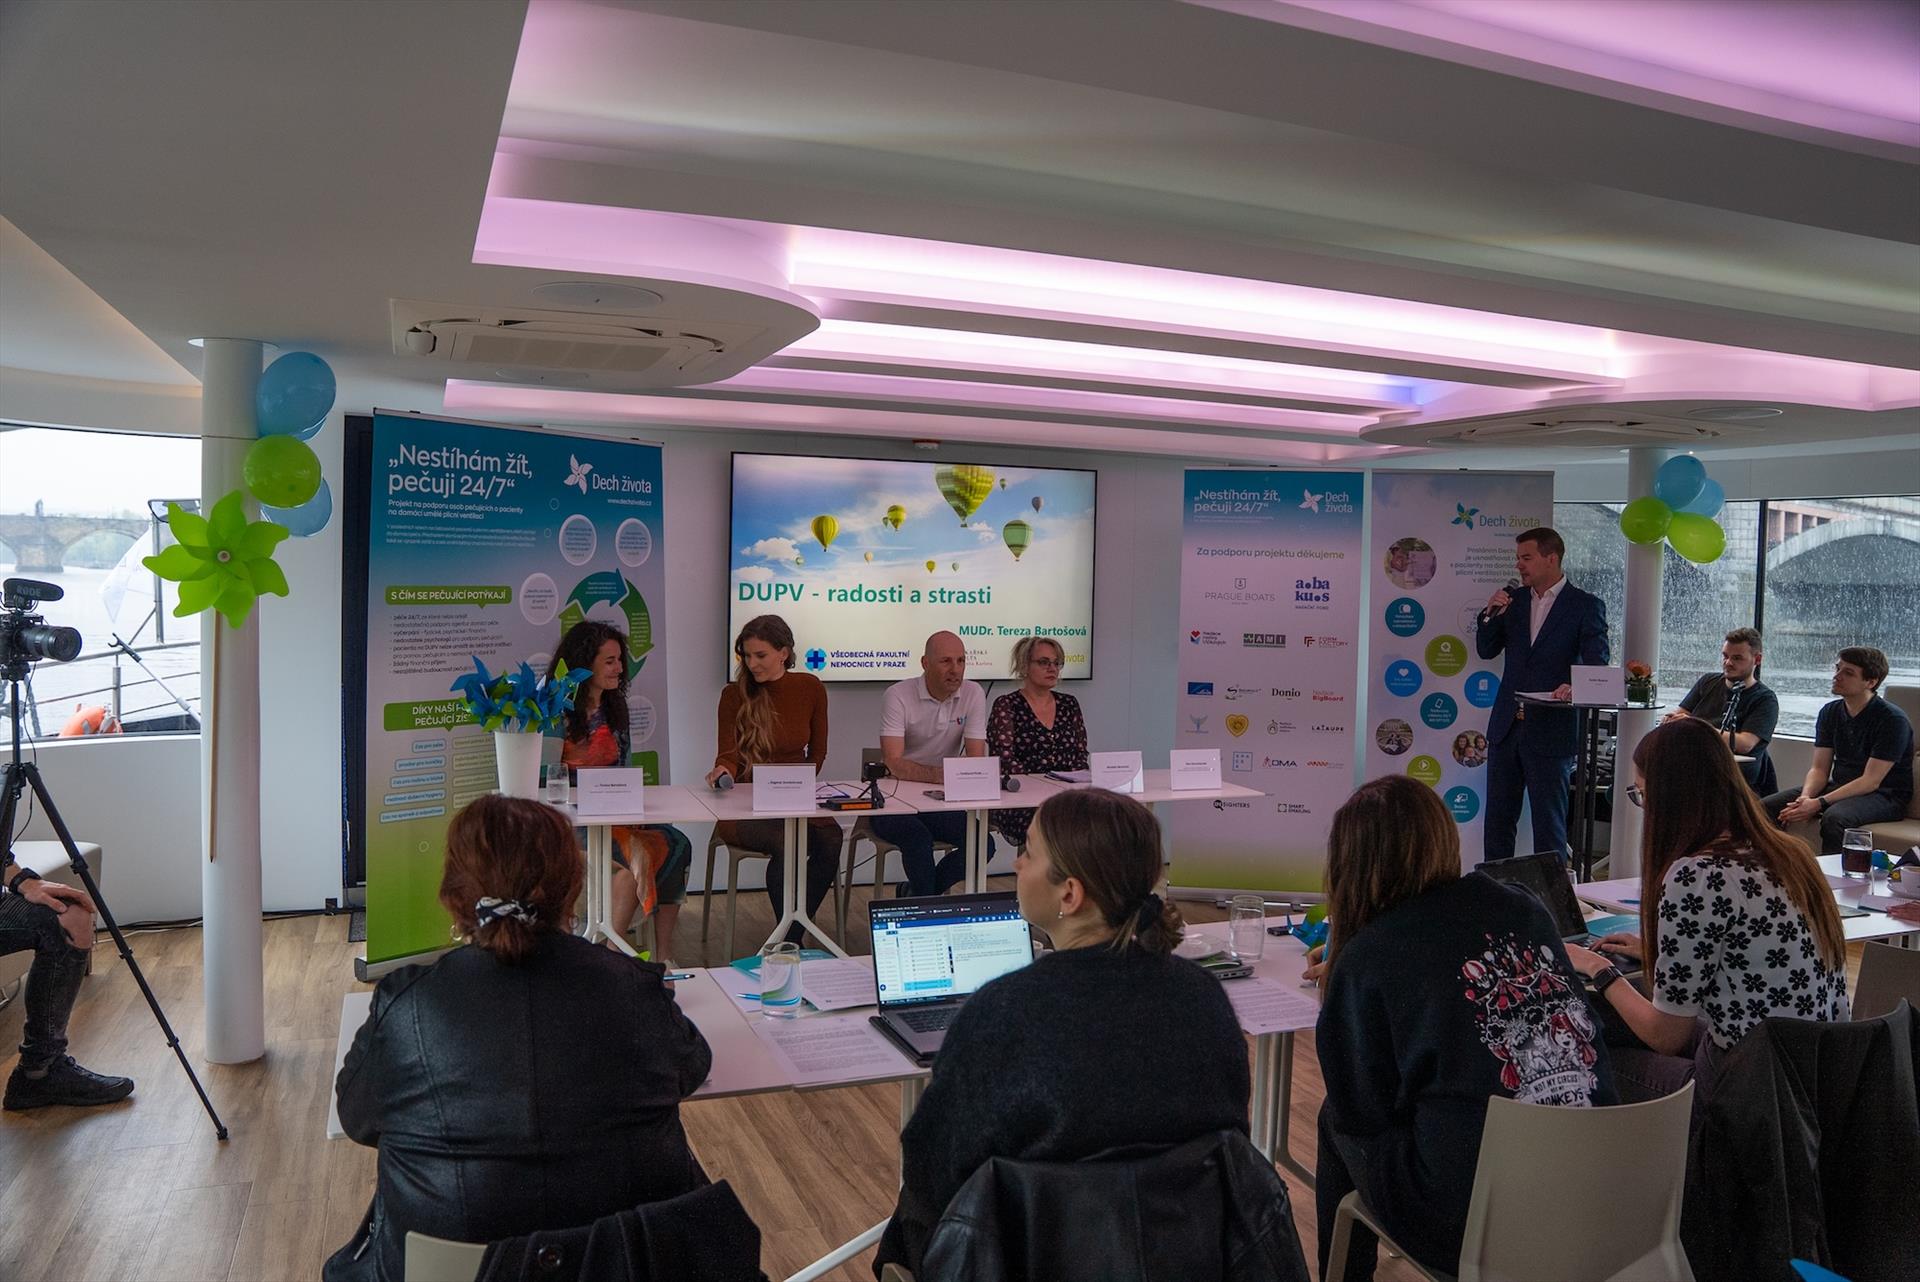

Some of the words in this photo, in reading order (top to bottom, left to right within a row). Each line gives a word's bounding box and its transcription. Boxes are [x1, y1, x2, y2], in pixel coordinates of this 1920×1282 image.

[388, 443, 501, 473] „Nestíhám
[505, 453, 532, 479] žít,
[389, 470, 455, 499] pečuji
[460, 475, 515, 500] 24/7“
[592, 473, 619, 491] Dech
[621, 475, 652, 494] života
[1263, 488, 1281, 503] žít,
[1325, 491, 1350, 502] Dech
[388, 499, 413, 508] Projekt
[423, 501, 449, 509] podporu
[499, 506, 524, 514] pacienty
[1194, 502, 1232, 514] pečuji
[1325, 502, 1353, 513] života
[1479, 514, 1507, 528] Dech
[1508, 513, 1542, 529] života
[1196, 547, 1209, 556] Za
[1210, 548, 1253, 558] podporu
[1254, 549, 1296, 559] projektu
[1297, 549, 1345, 560] děkujeme
[391, 591, 398, 601] S
[398, 588, 416, 601] ČÍM
[417, 591, 429, 601] SE
[430, 589, 467, 601] PEČUJÍCÍ
[468, 589, 507, 601] POTÝKAJÍ
[739, 582, 804, 602] DUPV
[828, 584, 903, 603] radosti
[910, 588, 921, 604] a
[928, 586, 992, 604] strasti
[1204, 592, 1242, 601] PRAGUE
[1245, 592, 1276, 601] BOATS
[959, 625, 994, 636] MUDr.
[997, 625, 1032, 636] Tereza
[1034, 625, 1088, 637] Bartošová
[830, 650, 875, 658] VŠEOBECNÁ
[876, 650, 910, 658] FAKULTNÍ
[830, 661, 874, 669] NEMOCNICE
[875, 661, 882, 669] V
[883, 661, 907, 669] PRAZE
[1271, 687, 1301, 697] Donio
[412, 703, 434, 715] DÍKY
[434, 700, 455, 713] NAŠÍ
[415, 713, 454, 726] PEČUJÍCÍ
[1533, 1080, 1547, 1094] NOT
[1546, 1078, 1557, 1088] MY
